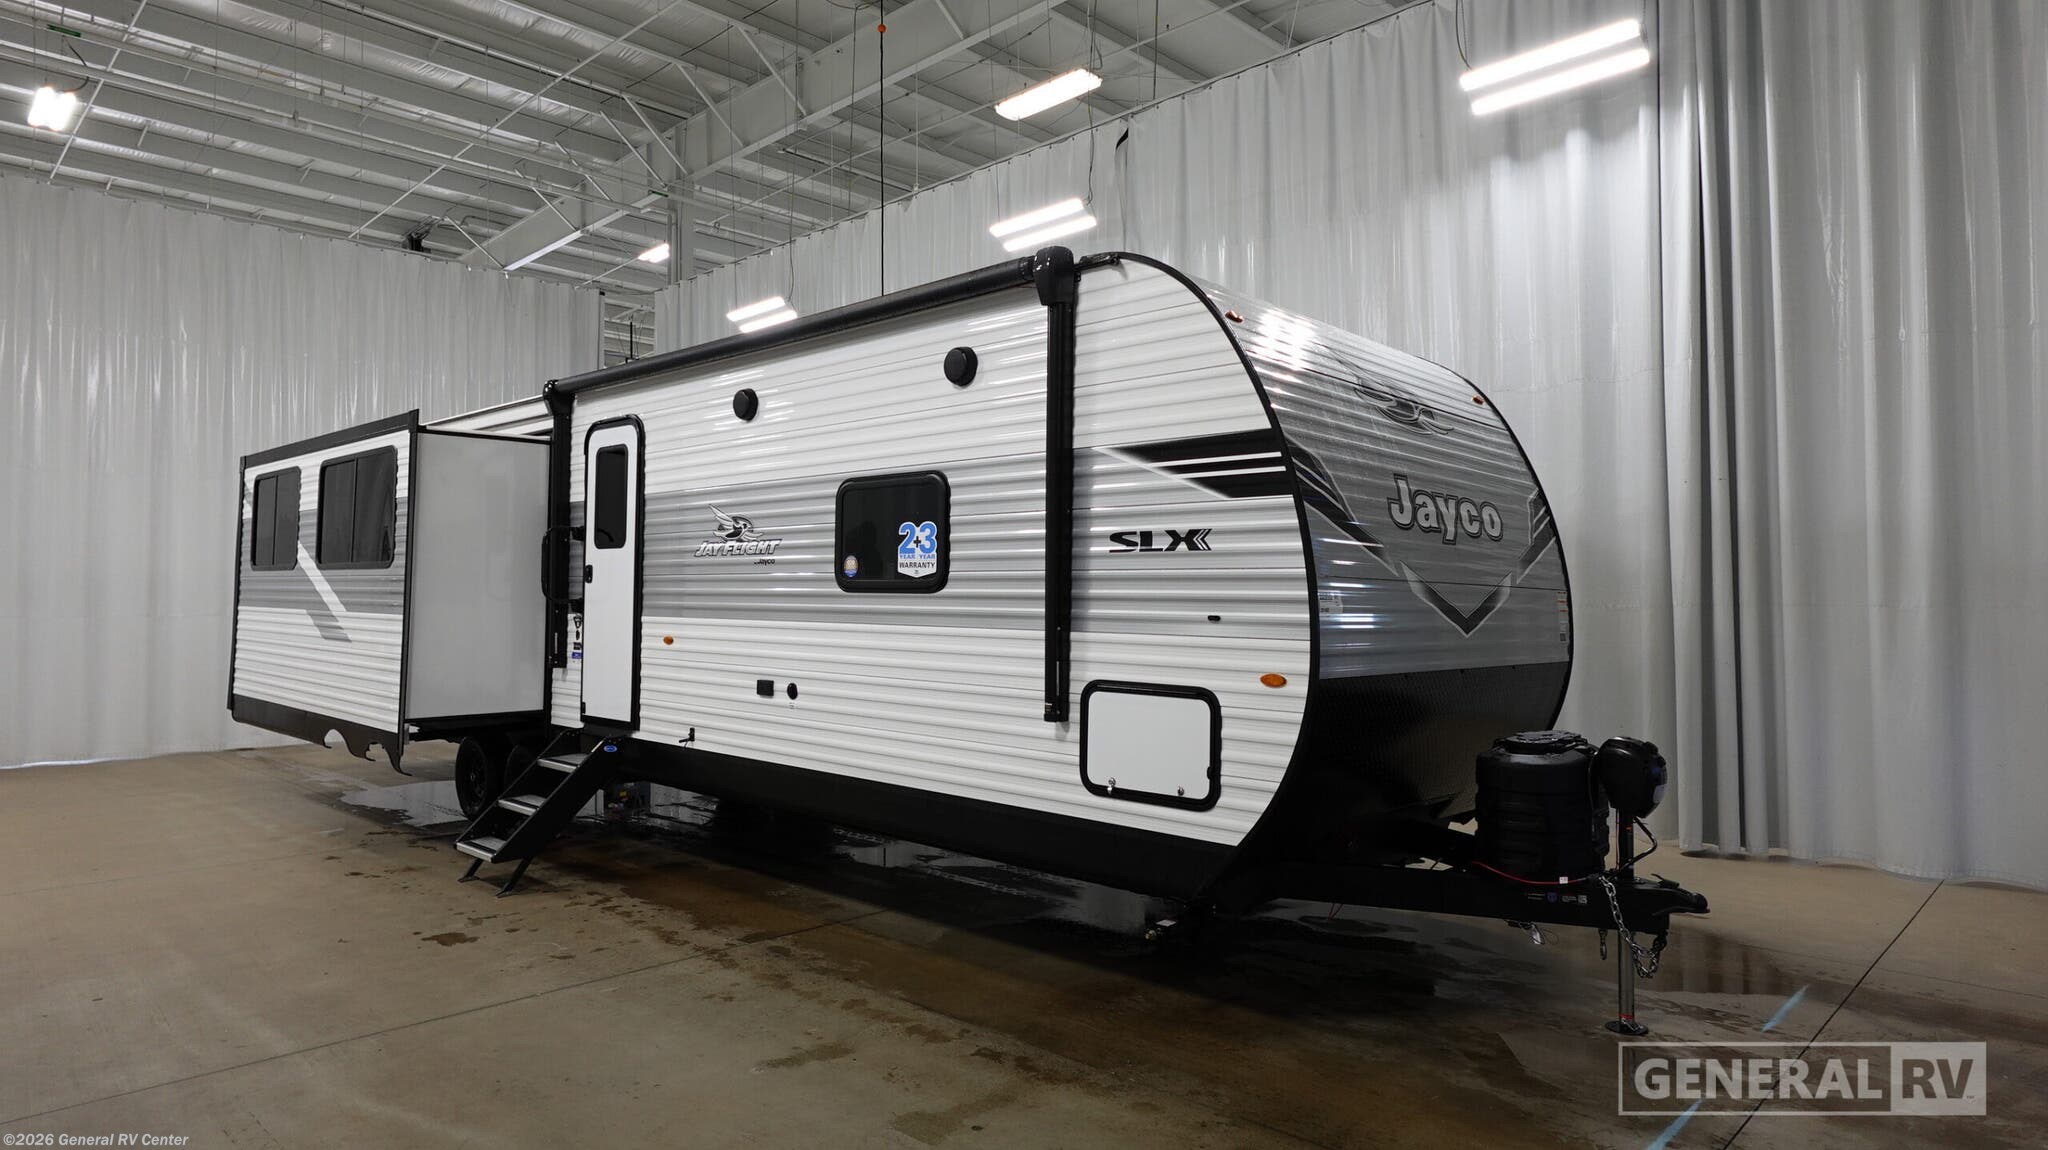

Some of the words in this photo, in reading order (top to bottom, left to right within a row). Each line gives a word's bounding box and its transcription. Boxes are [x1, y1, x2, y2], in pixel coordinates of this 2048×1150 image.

[1387, 473, 1503, 545] Jayco
[694, 541, 721, 557] JAY
[721, 539, 783, 556] FLIGHT
[1109, 529, 1212, 553] SLX
